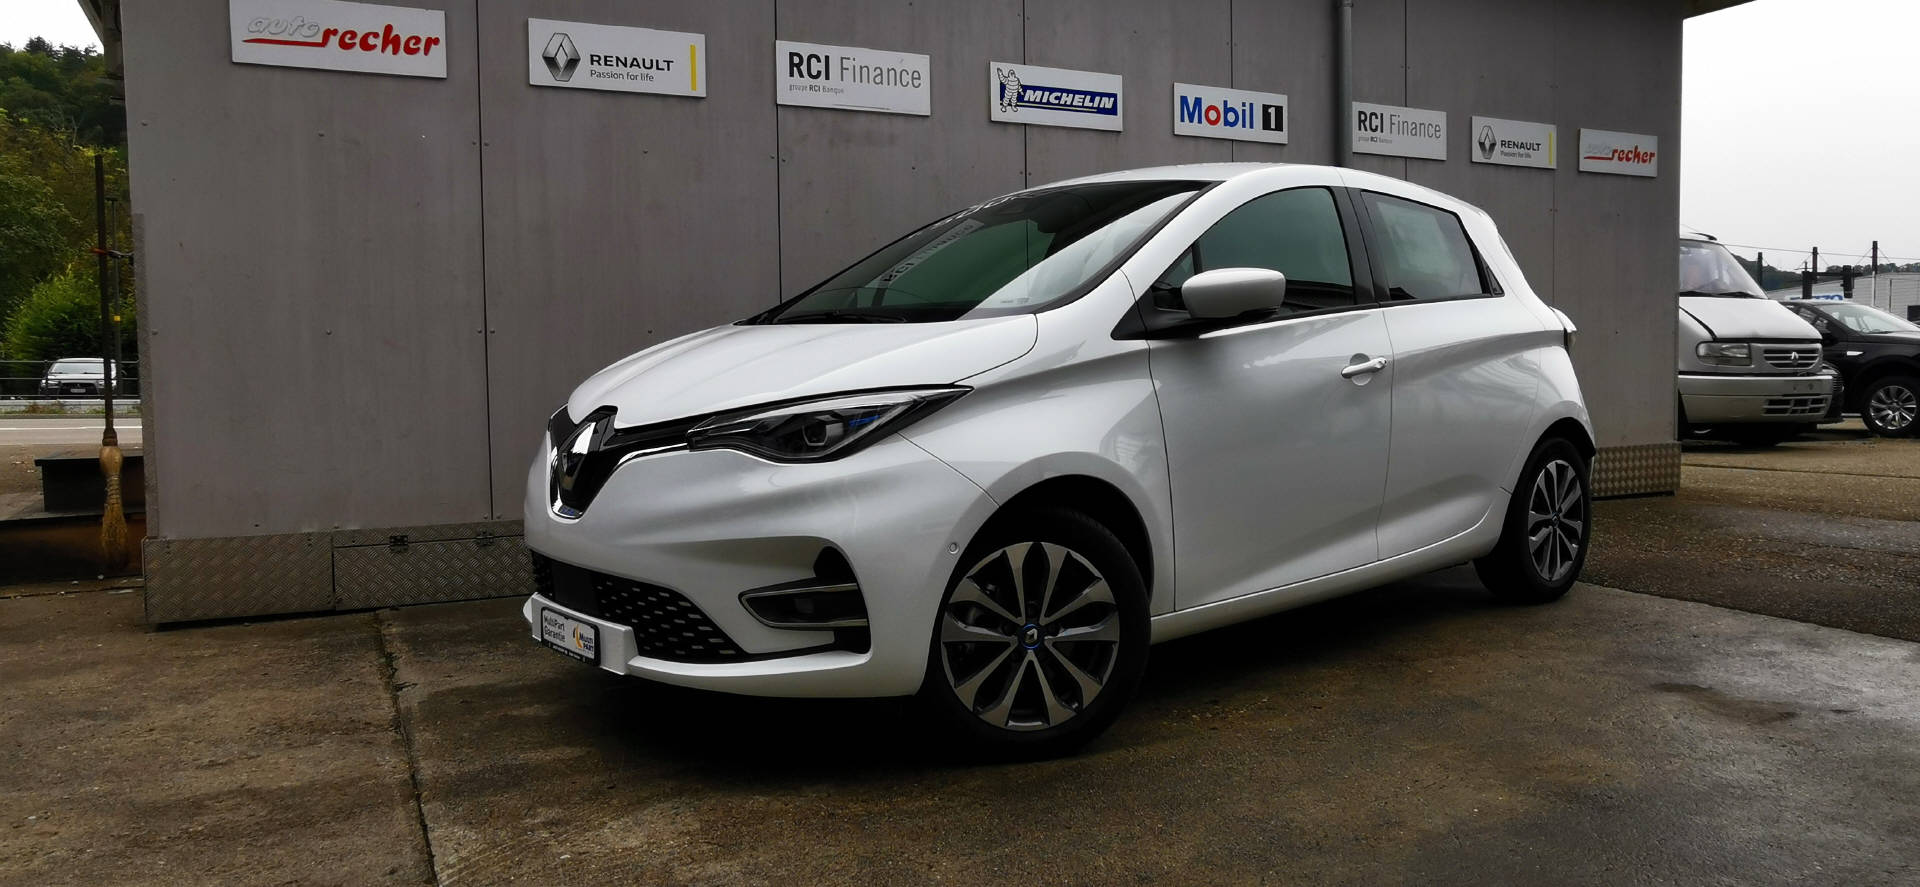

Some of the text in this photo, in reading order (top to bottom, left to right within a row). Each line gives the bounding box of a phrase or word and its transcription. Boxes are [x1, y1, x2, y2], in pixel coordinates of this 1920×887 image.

[247, 16, 441, 56] auto recher
[589, 54, 674, 71] RENAULT
[788, 51, 922, 89] RCI Finance
[590, 69, 654, 82] Passion for life
[809, 84, 821, 93] RCI
[1023, 89, 1115, 109] MICHELIN
[1179, 95, 1254, 129] Mobil
[1357, 110, 1441, 139] RCI Finance
[1500, 139, 1542, 152] RENAULT
[1611, 145, 1656, 164] recher
